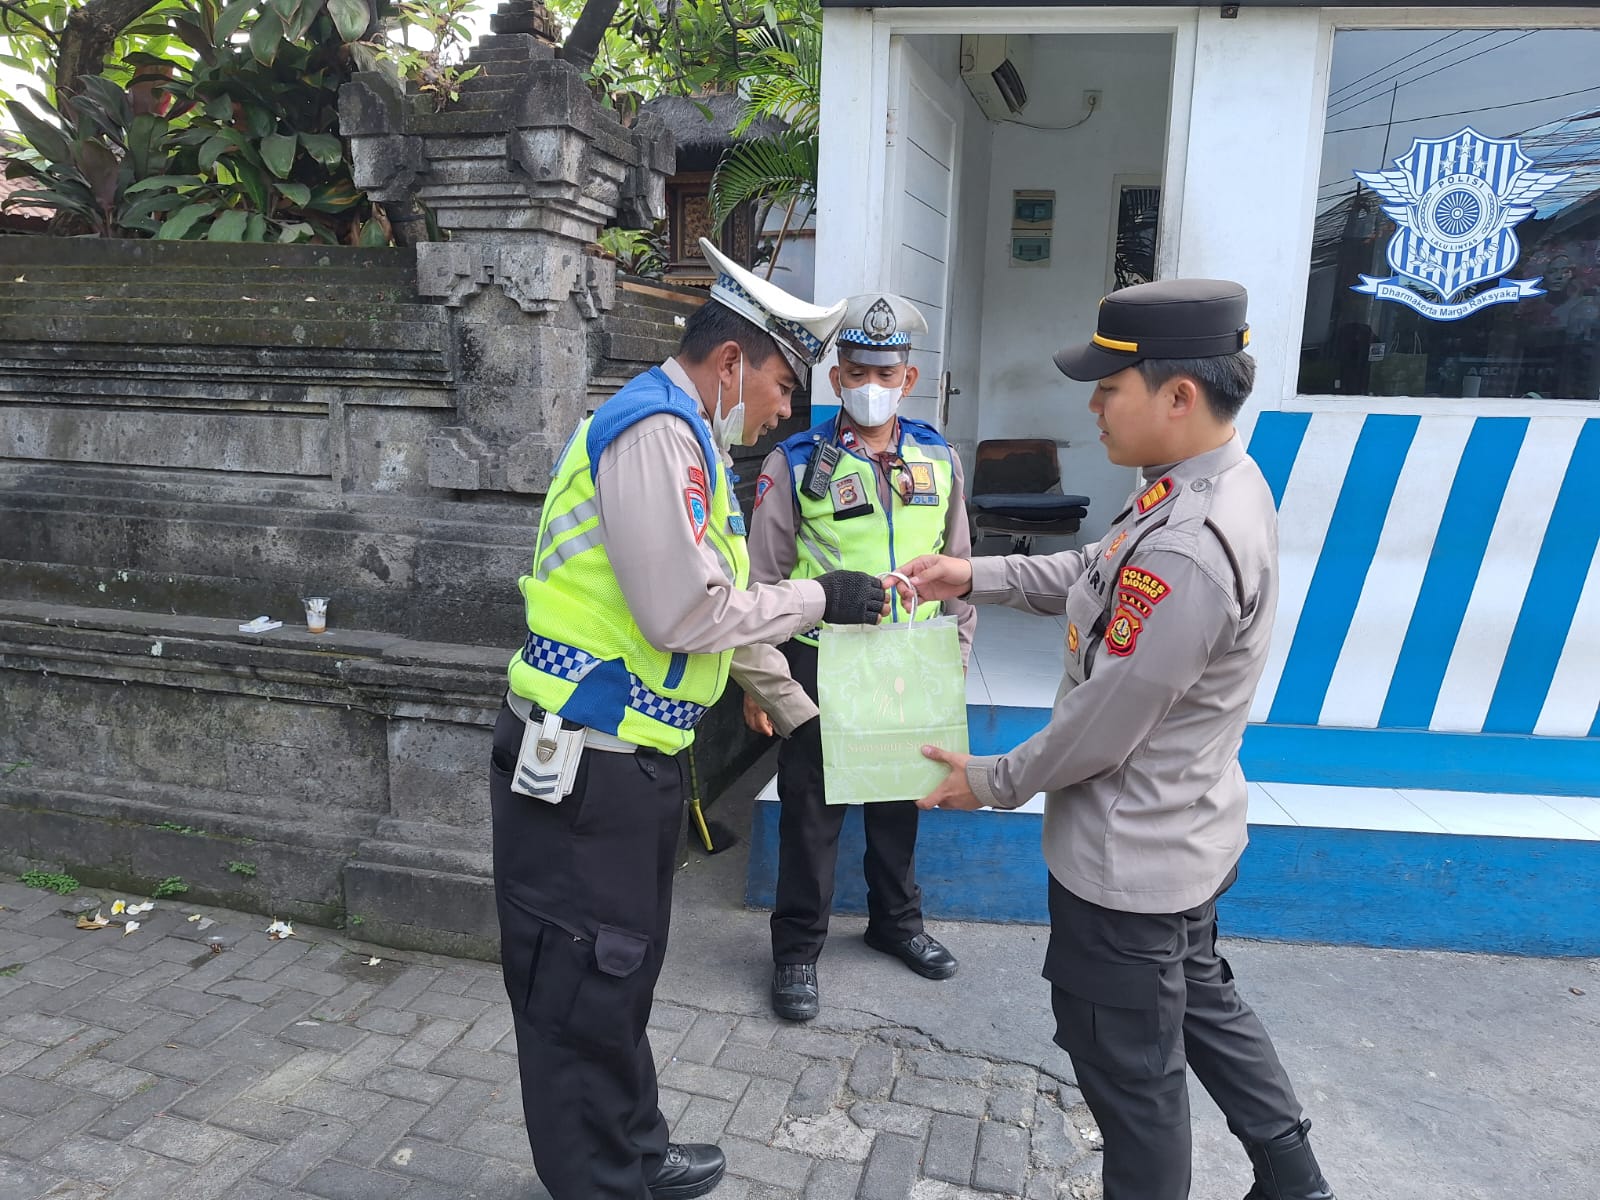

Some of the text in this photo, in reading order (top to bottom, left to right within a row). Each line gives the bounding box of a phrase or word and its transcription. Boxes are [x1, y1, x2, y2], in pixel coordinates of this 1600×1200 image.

[1438, 175, 1484, 189] POLISI
[1430, 237, 1478, 251] LALU LINTAS
[1381, 286, 1517, 316] Dharmakerta Marga Raksyaka
[912, 496, 938, 505] OLRI
[1123, 569, 1166, 595] POLRES
[1121, 594, 1149, 613] BALI
